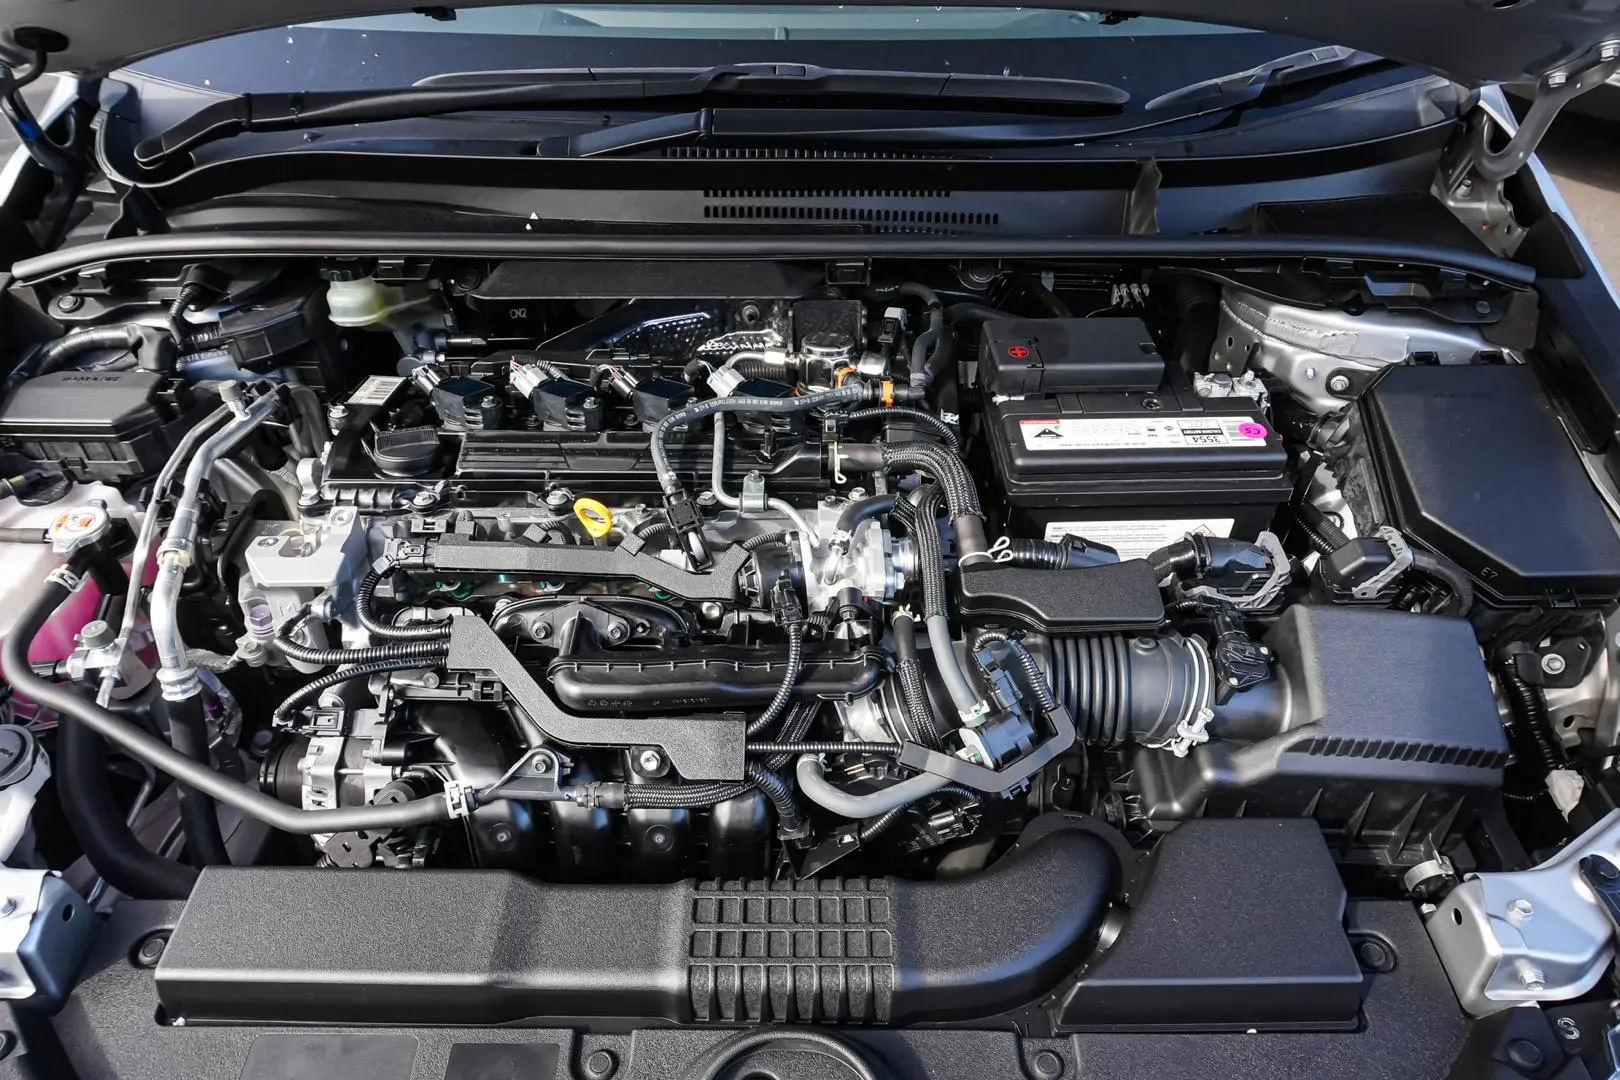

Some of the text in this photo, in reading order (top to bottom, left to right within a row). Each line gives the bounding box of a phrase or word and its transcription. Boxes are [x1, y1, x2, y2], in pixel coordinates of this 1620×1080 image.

[1192, 435, 1221, 443] 3554
[1480, 566, 1498, 580] E7
[1557, 1017, 1580, 1040] S
